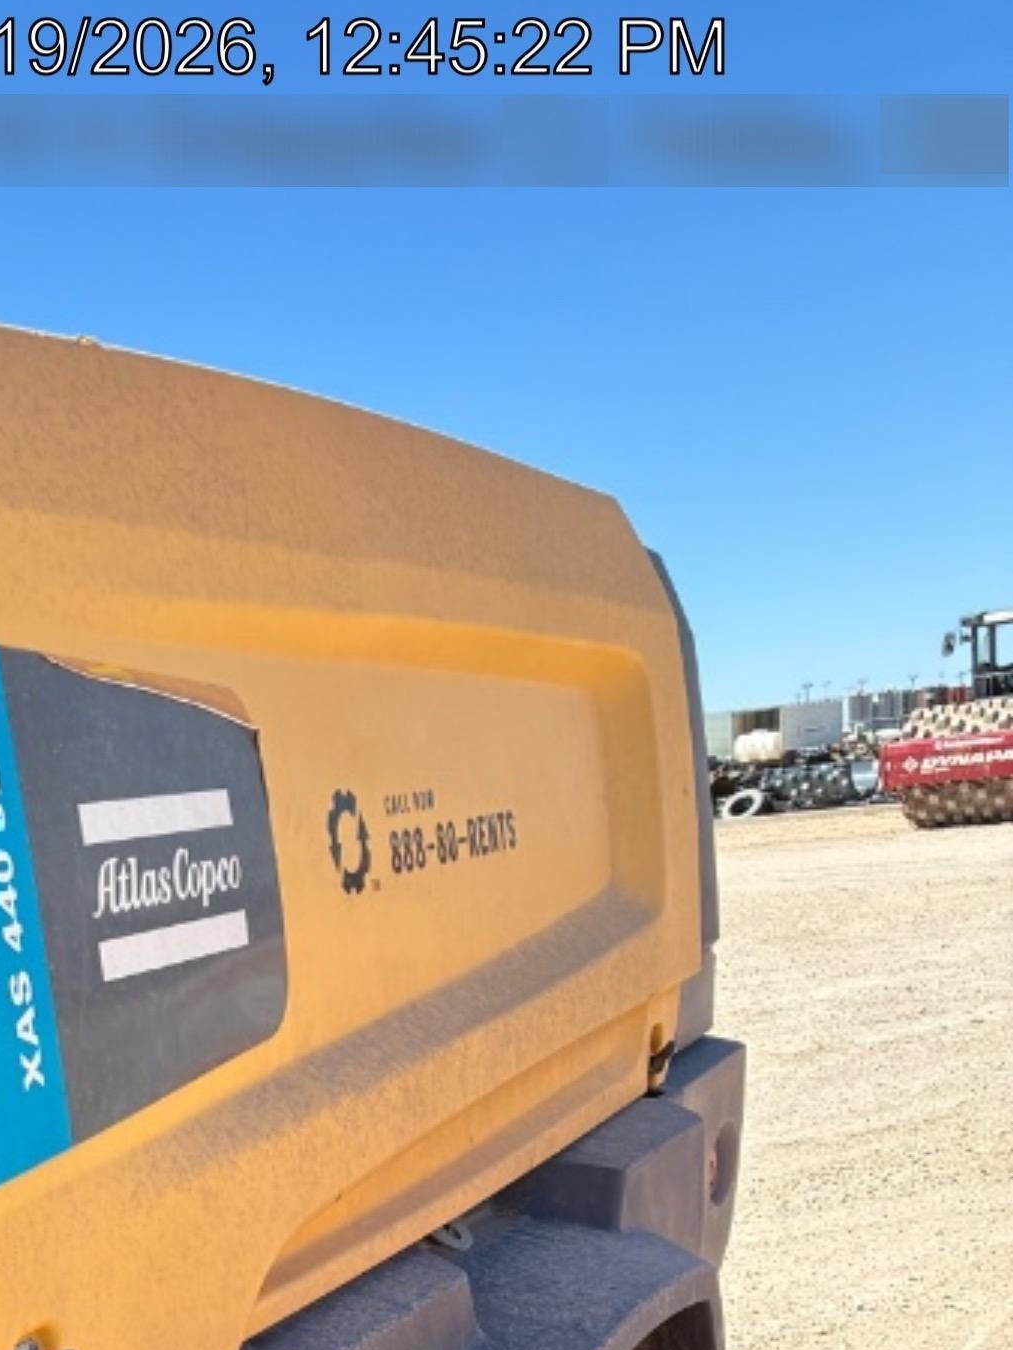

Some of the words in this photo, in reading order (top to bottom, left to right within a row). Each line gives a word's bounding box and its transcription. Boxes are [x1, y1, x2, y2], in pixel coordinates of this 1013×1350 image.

[384, 794, 411, 815] CALL
[389, 810, 516, 874] 888-80-RENTS
[92, 856, 172, 919] Atlas
[172, 847, 242, 907] Copco
[10, 970, 45, 1092] XAS
